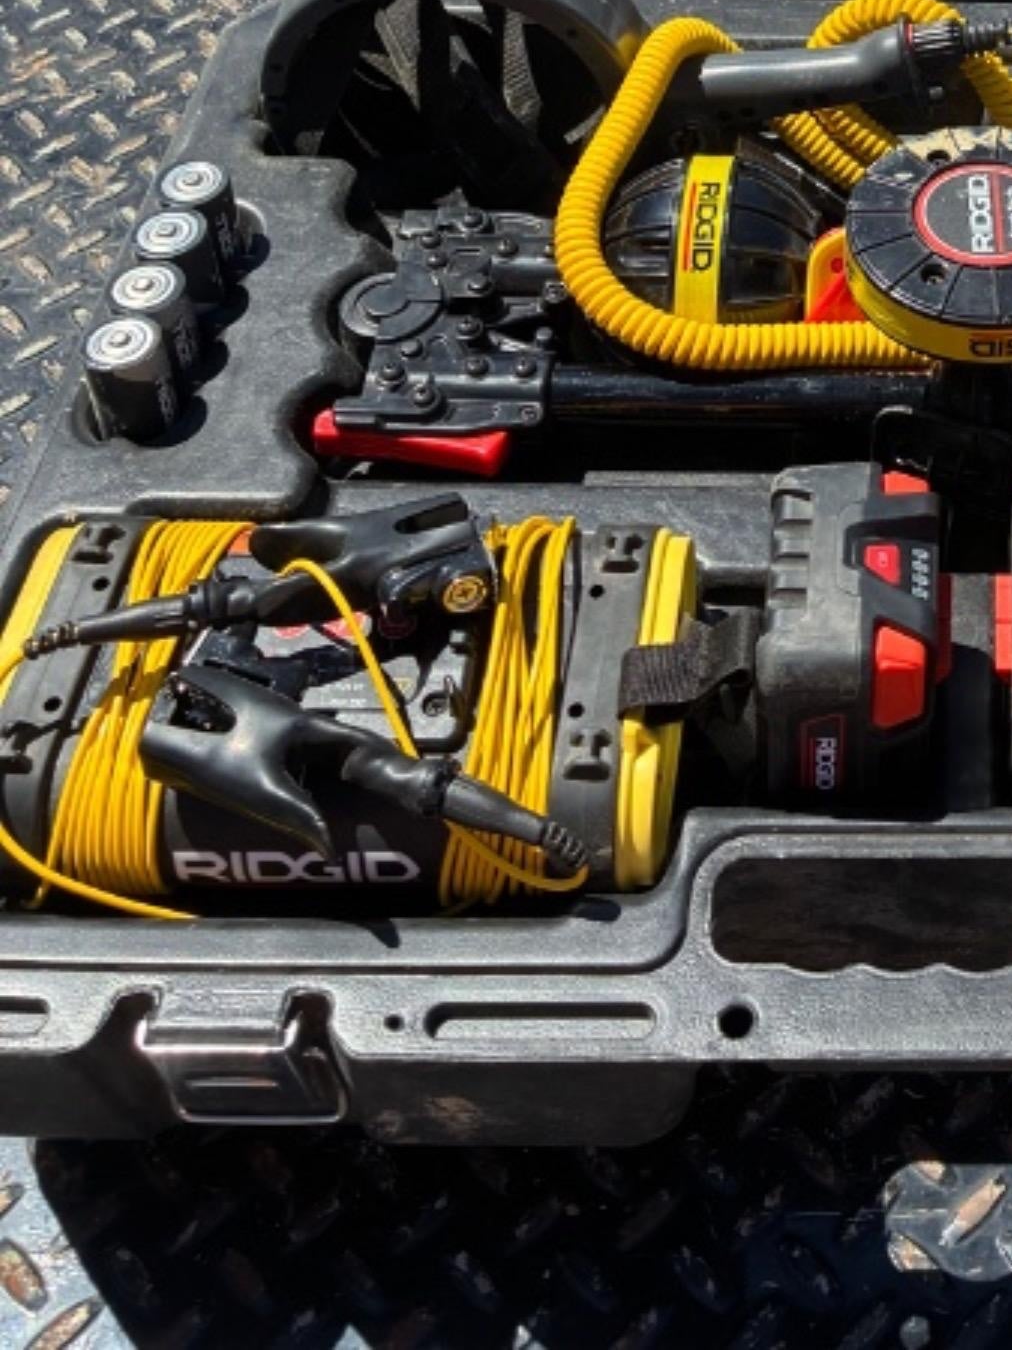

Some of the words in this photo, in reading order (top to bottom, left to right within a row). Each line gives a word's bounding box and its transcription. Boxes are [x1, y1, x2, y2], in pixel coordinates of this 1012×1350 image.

[692, 182, 721, 271] RIDGID
[968, 175, 996, 253] RIDGID
[815, 737, 837, 790] RIDGID
[172, 851, 421, 884] RIDGID
